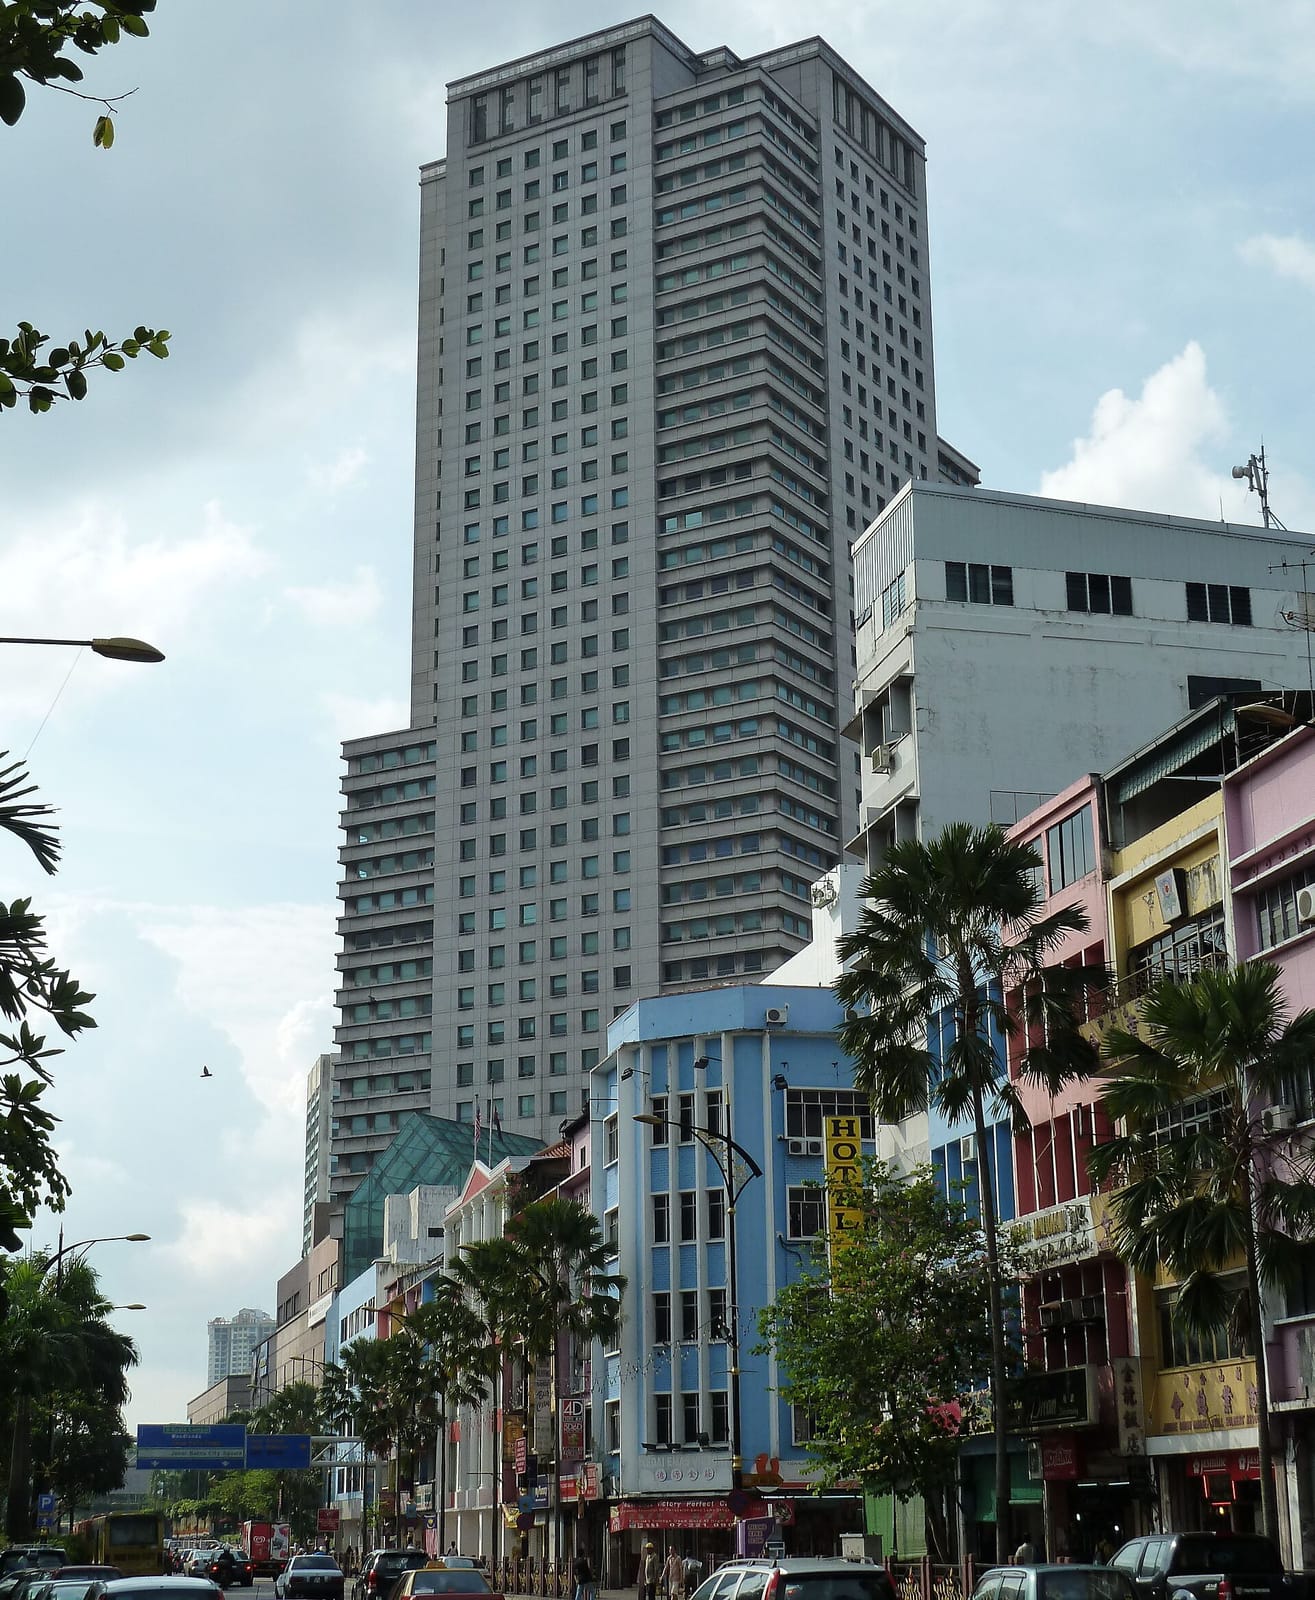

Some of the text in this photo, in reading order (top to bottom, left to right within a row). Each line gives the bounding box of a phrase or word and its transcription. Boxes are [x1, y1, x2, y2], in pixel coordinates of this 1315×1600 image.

[831, 1119, 859, 1231] HOTEL
[563, 1400, 583, 1416] 4D
[41, 1497, 52, 1509] P
[686, 1499, 714, 1508] Perfect
